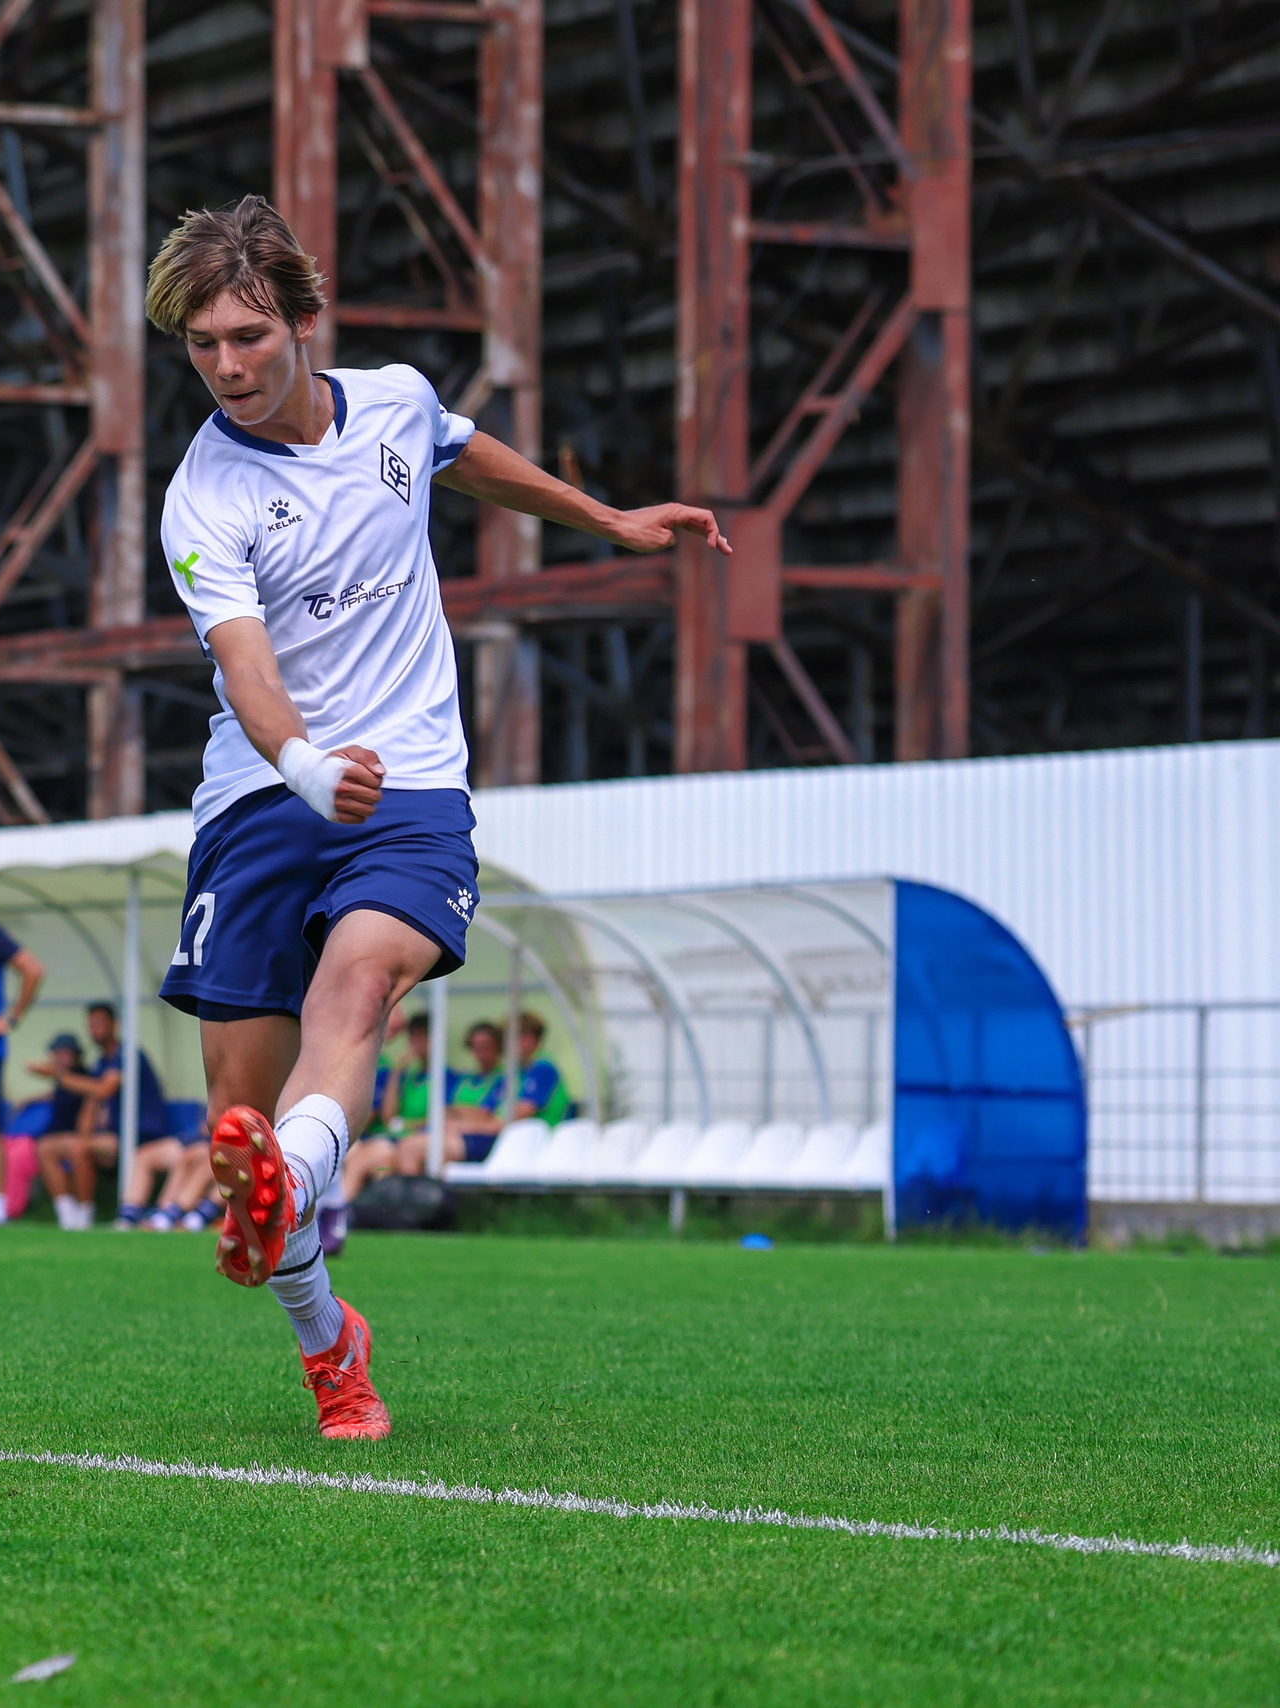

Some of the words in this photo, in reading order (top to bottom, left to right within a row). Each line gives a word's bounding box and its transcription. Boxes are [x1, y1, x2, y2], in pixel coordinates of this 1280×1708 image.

[267, 514, 303, 533] KELME
[339, 581, 366, 601] ДСК
[446, 897, 471, 925] KELME
